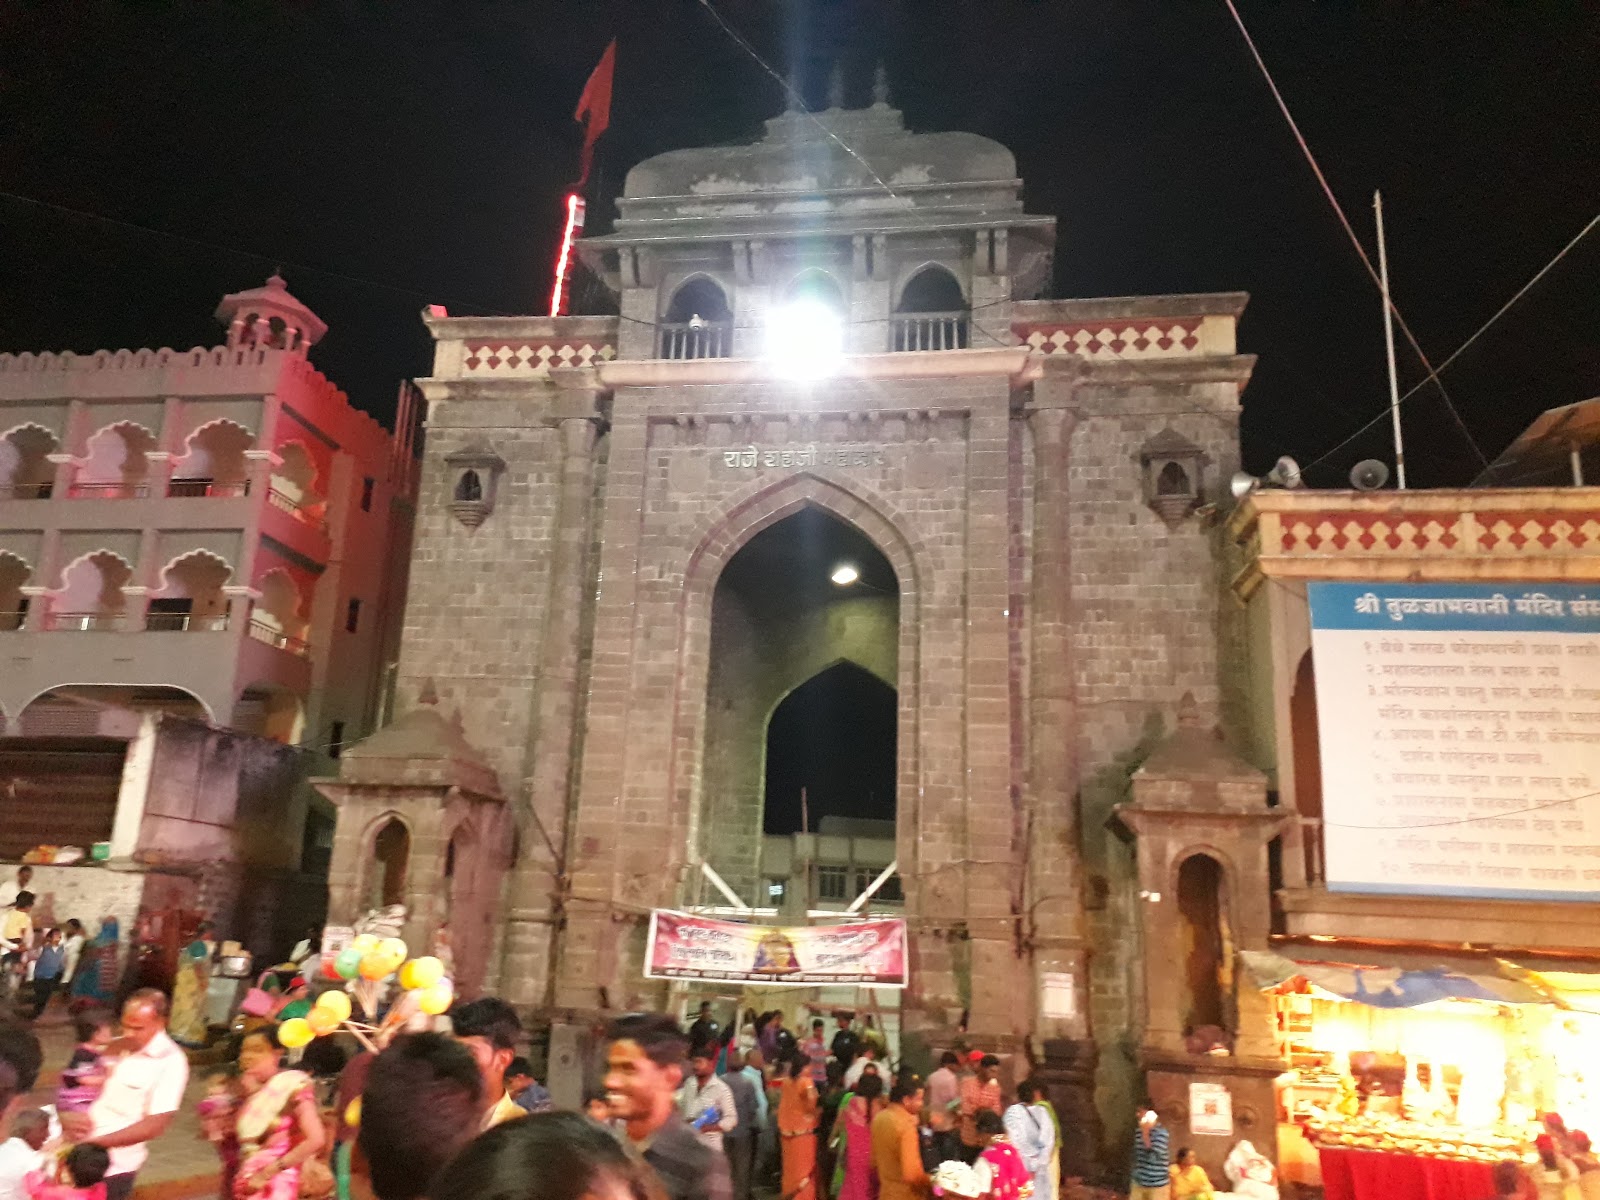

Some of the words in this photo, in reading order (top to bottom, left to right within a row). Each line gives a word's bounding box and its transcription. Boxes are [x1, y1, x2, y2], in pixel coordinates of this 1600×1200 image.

[723, 445, 759, 468] राजे
[1354, 592, 1380, 614] श्री
[1383, 593, 1510, 621] तुळजाभवानी
[1514, 592, 1565, 616] मंदिर
